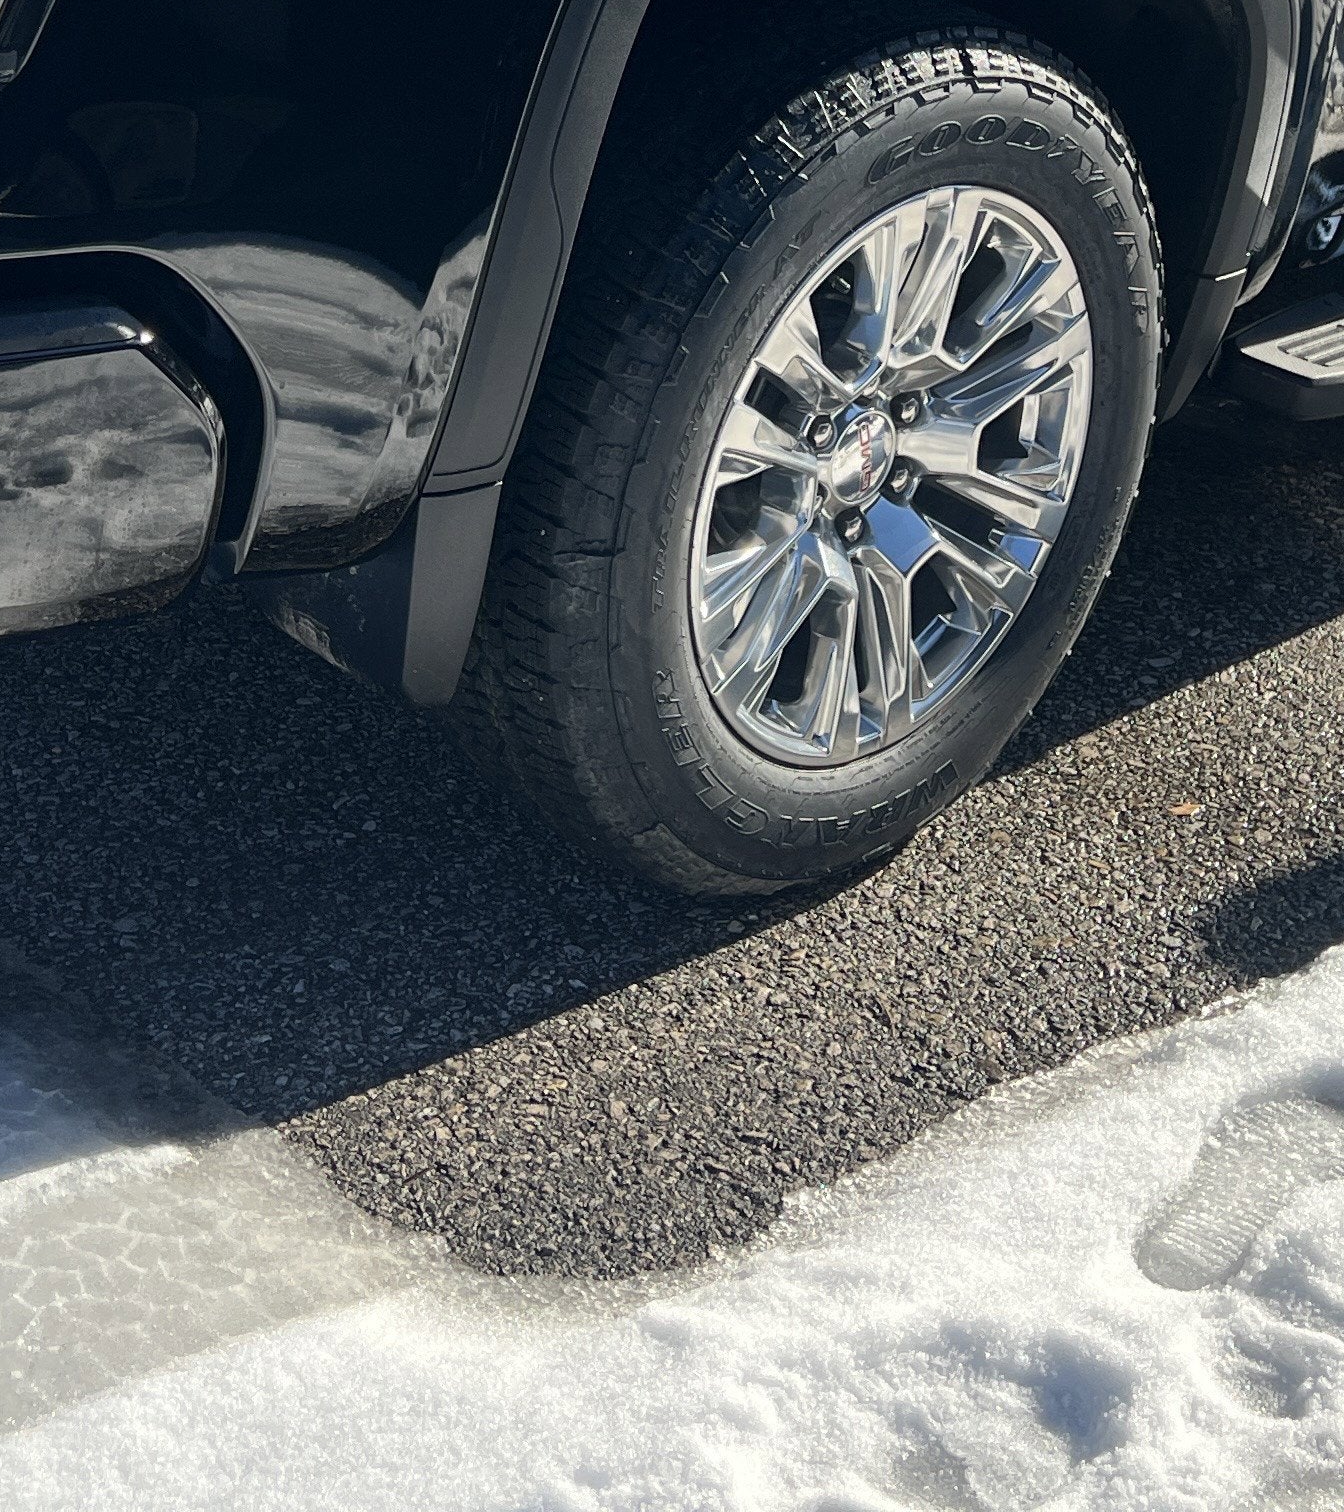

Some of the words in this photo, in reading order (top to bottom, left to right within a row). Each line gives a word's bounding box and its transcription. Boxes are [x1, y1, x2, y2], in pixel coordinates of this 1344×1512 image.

[867, 113, 1149, 334] GOODYEAR
[858, 422, 873, 493] GMC
[651, 667, 960, 850] WRANGLER
